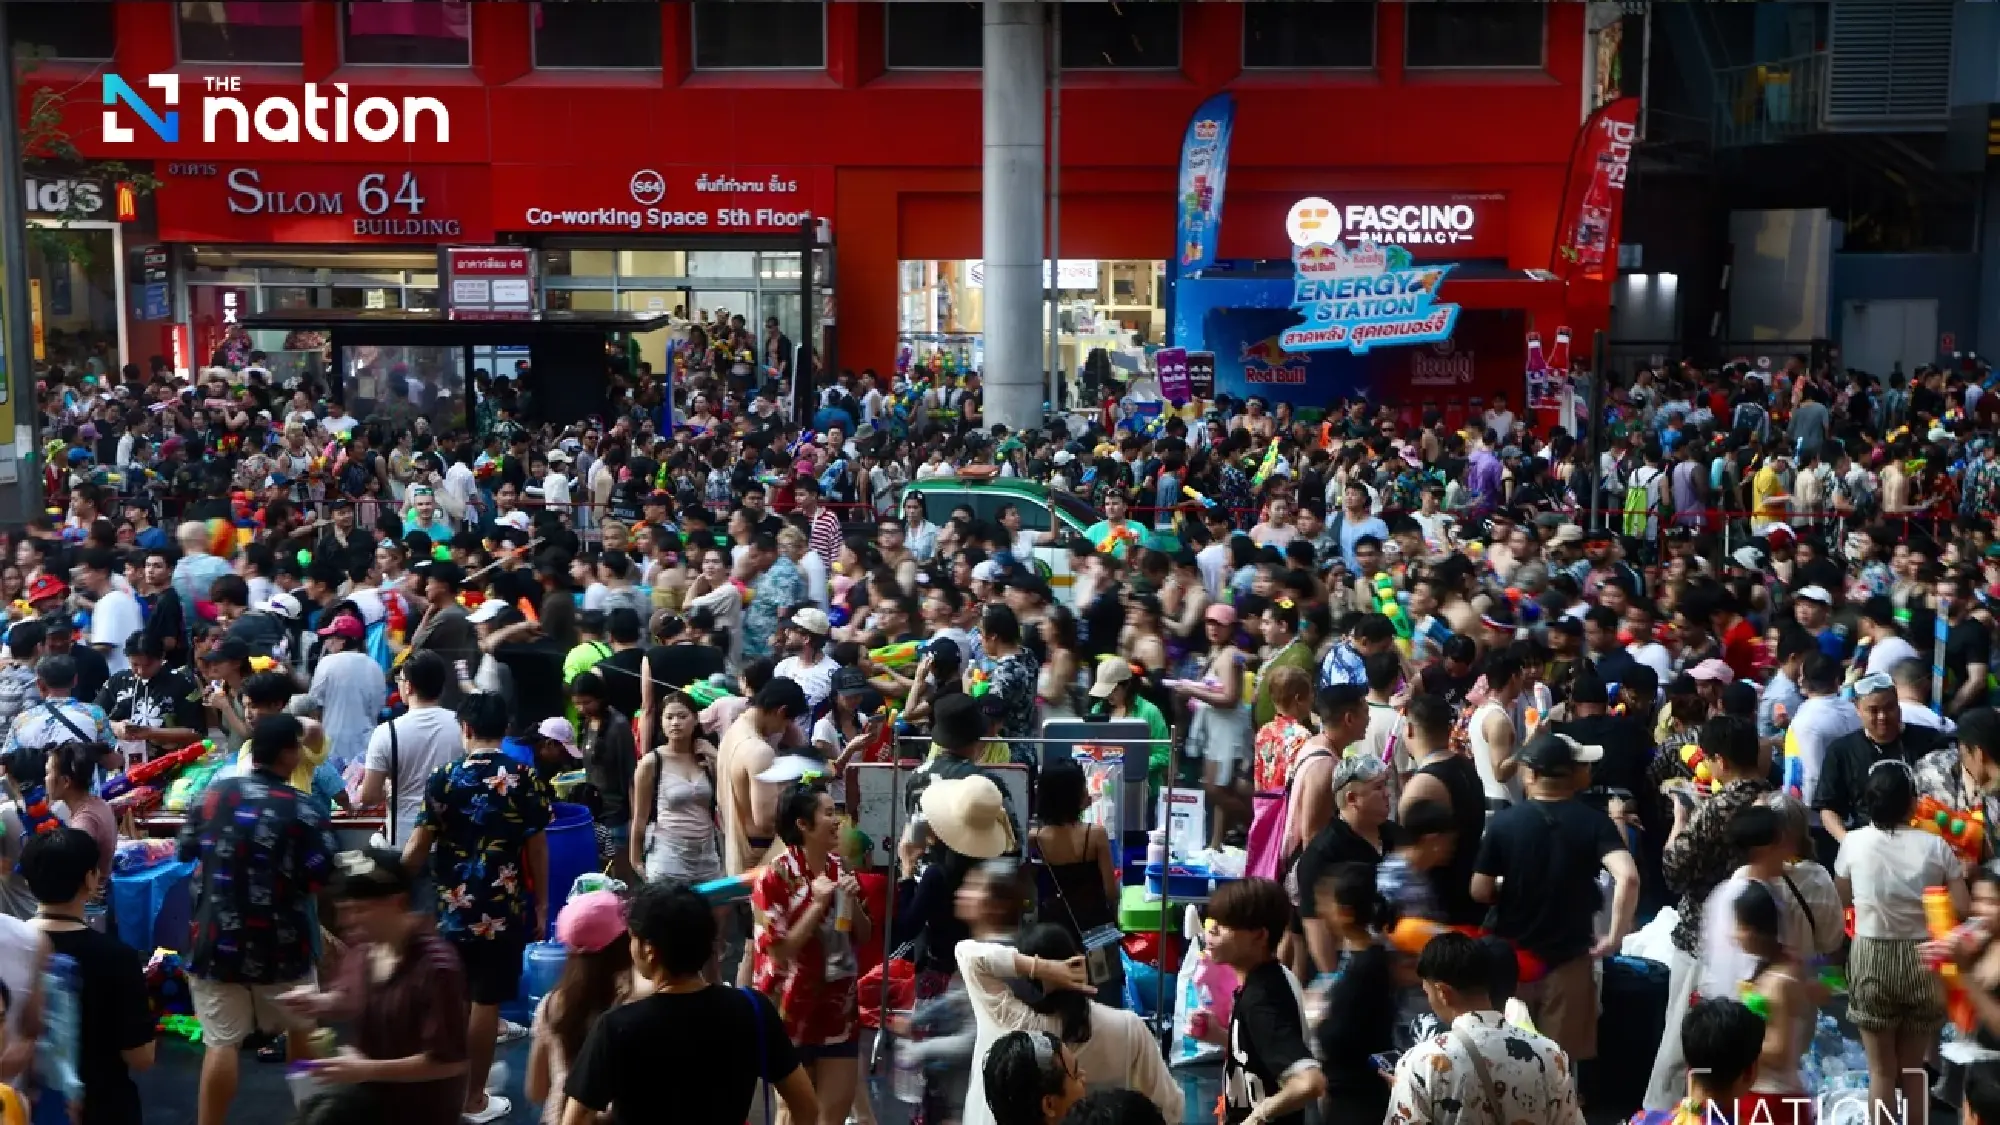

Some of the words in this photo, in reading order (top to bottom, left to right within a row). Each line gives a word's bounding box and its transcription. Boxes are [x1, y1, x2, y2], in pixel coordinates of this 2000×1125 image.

[168, 164, 218, 175] อาคาร
[357, 171, 424, 215] 64
[634, 181, 661, 193] S64
[526, 207, 641, 228] Co-working
[647, 208, 708, 228] Space
[717, 208, 751, 226] 5th
[756, 208, 811, 226] Floor
[1346, 205, 1475, 230] FASCINO
[353, 219, 461, 235] BUILDING
[1361, 232, 1460, 244] PHARMACY
[510, 260, 523, 268] 64
[1297, 273, 1415, 302] ENERGY
[1317, 295, 1416, 320] STATION
[1246, 367, 1273, 383] Red
[1276, 366, 1306, 383] Bull
